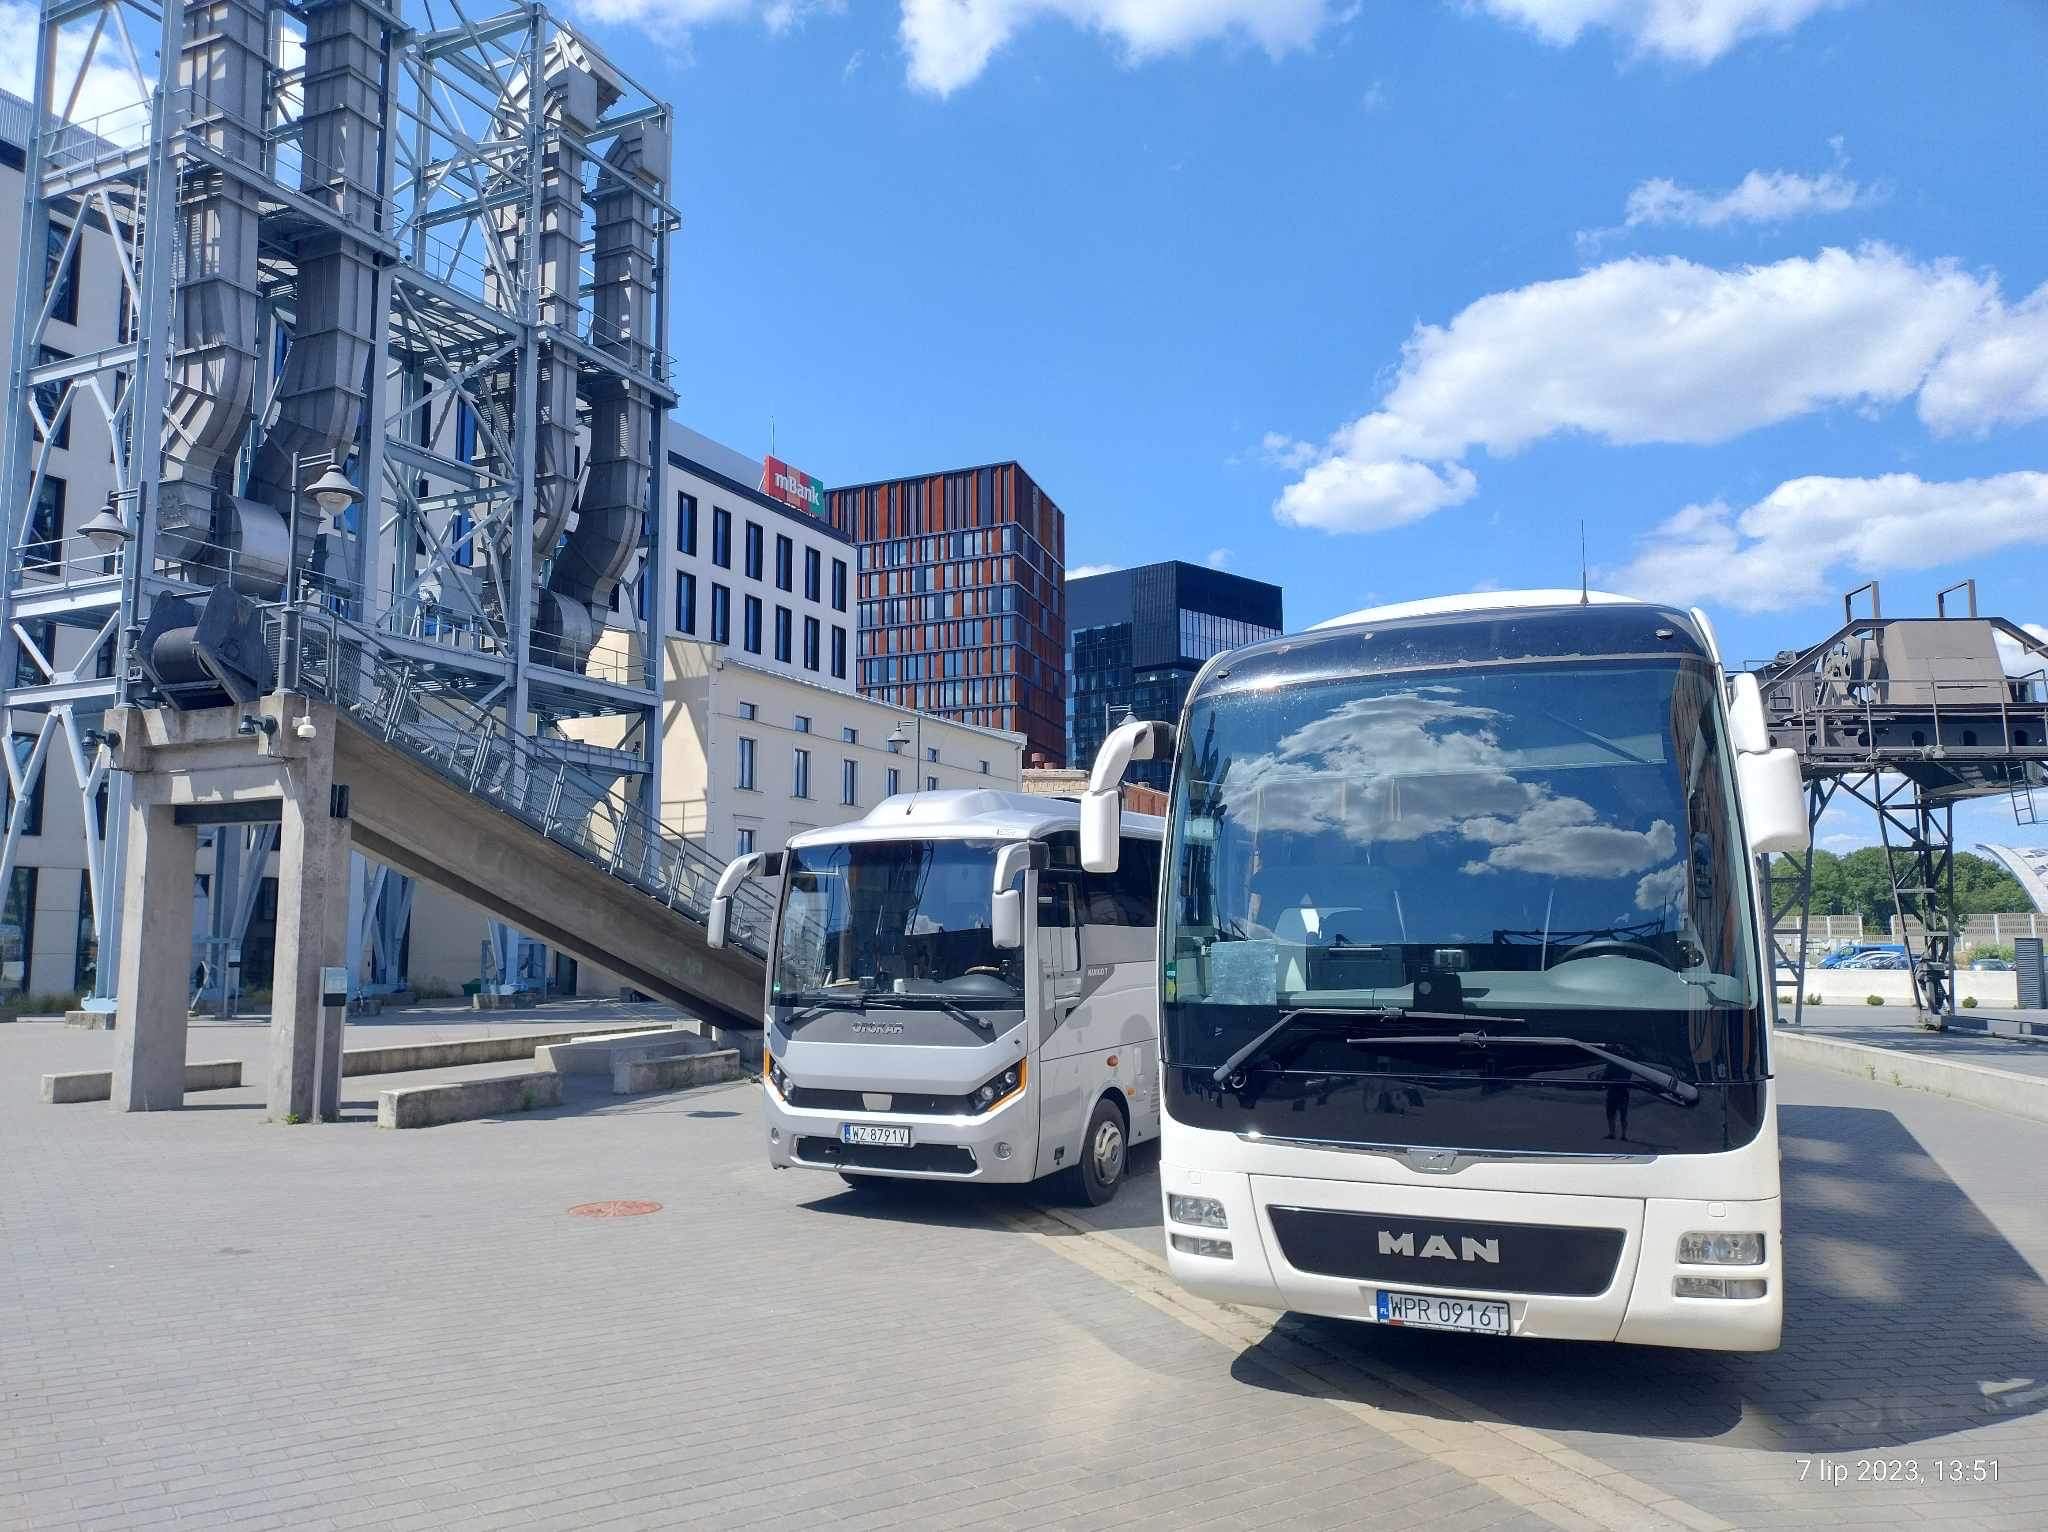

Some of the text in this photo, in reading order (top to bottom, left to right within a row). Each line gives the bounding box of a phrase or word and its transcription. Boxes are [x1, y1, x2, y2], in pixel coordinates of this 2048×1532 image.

[774, 473, 820, 506] mBank
[851, 1021, 904, 1034] OTOKAR
[852, 1126, 906, 1142] WZ 8791V
[1378, 1230, 1500, 1263] MAN
[1390, 1296, 1430, 1320] WPR
[1439, 1301, 1505, 1328] 0916T
